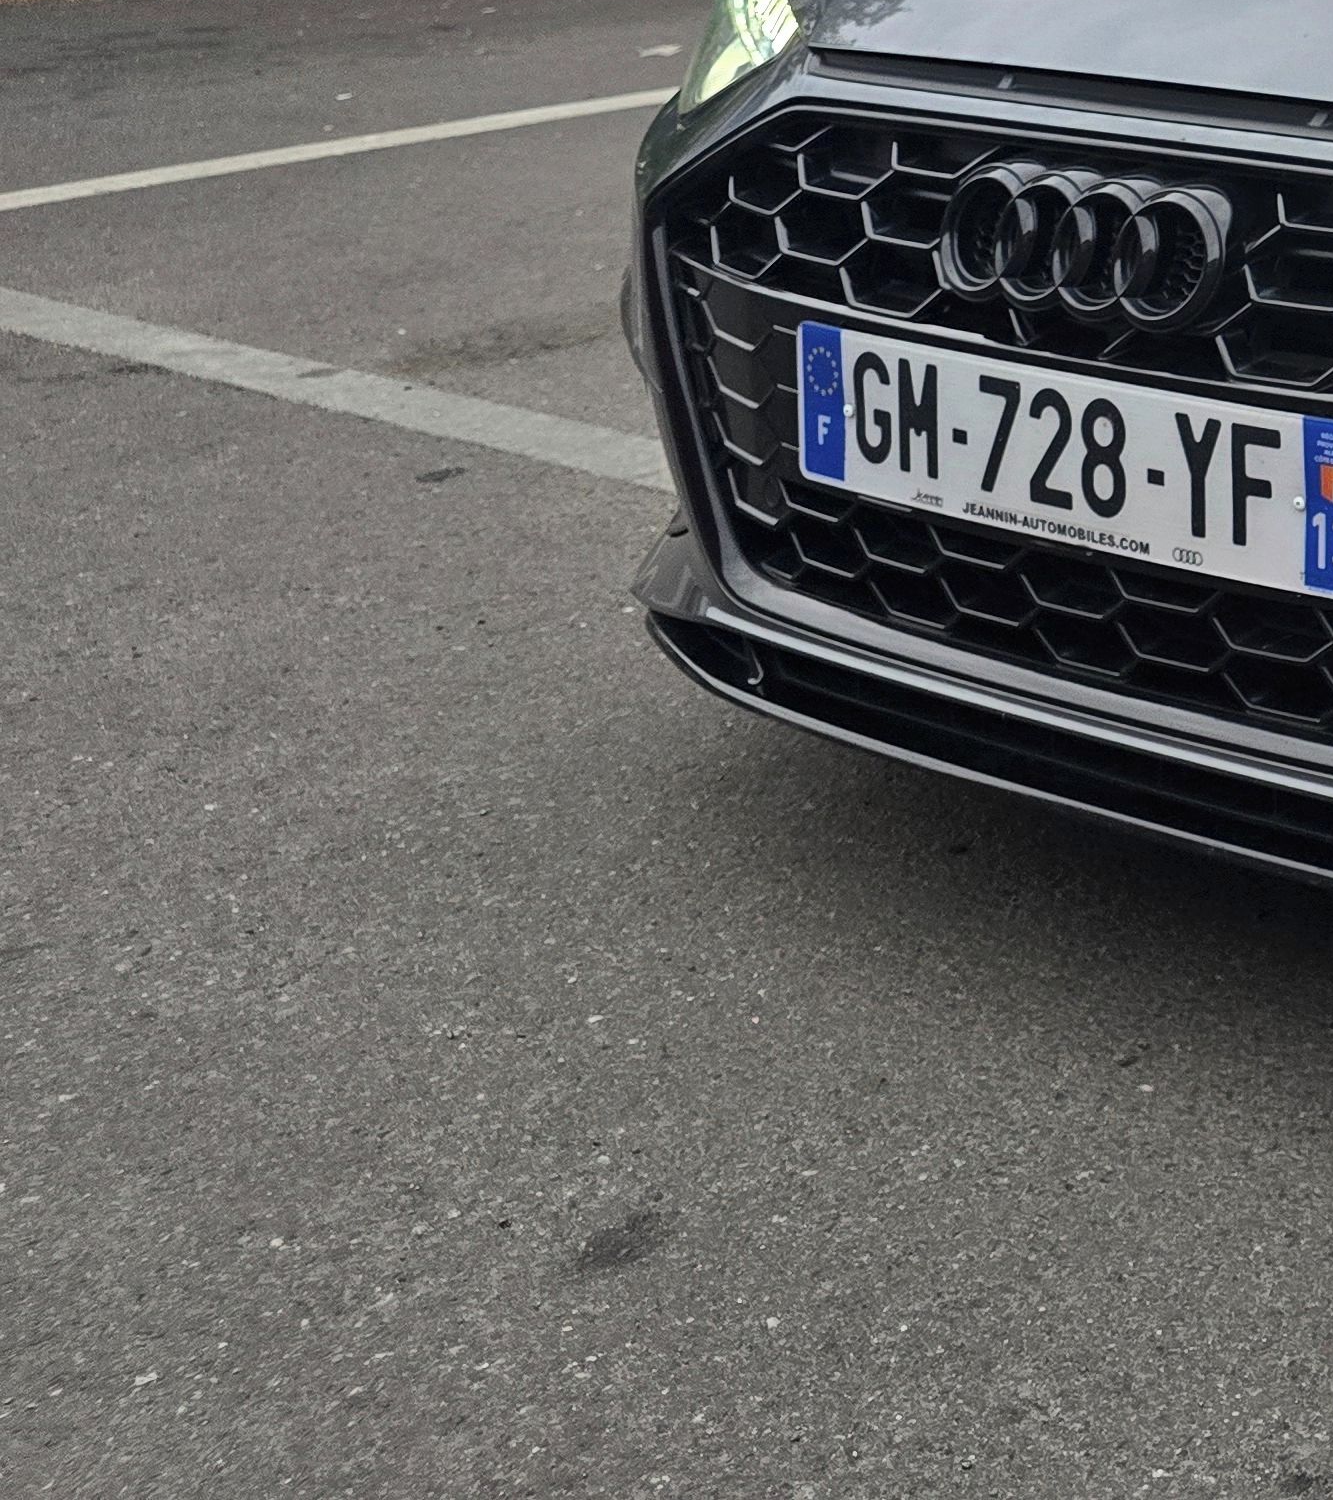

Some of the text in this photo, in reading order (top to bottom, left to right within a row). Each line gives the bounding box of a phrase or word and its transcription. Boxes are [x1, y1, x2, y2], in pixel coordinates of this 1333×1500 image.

[817, 415, 831, 445] F
[853, 351, 1281, 546] GM-728-YF
[962, 501, 1150, 555] JEANNIN-AUTOMOBILES.COM
